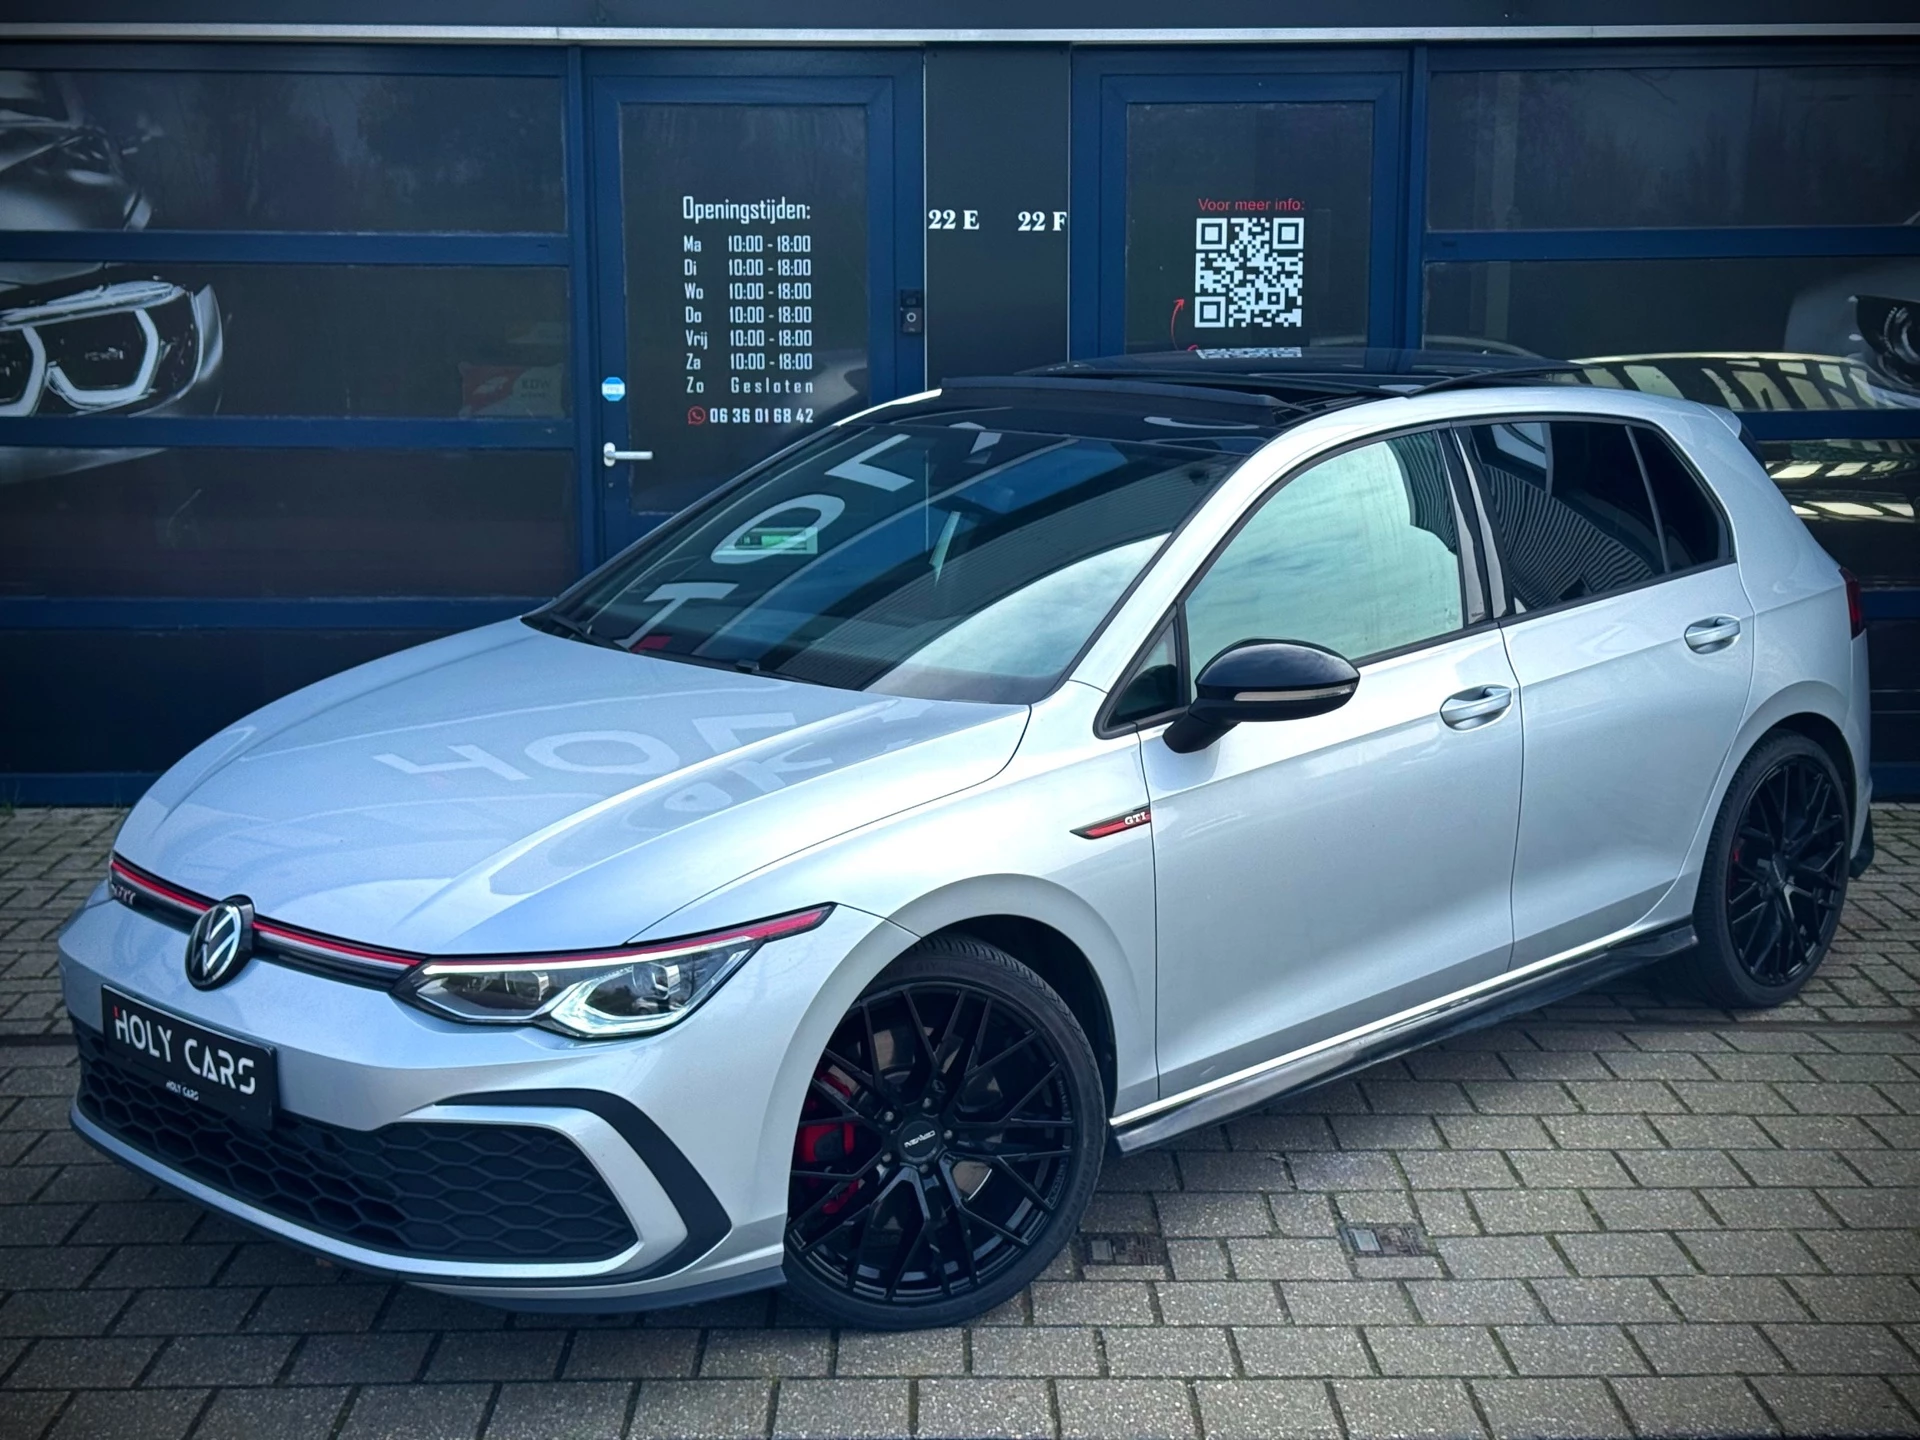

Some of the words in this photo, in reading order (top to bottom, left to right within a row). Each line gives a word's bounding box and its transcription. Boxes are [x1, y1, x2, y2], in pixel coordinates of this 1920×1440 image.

[682, 195, 811, 225] Openingstijden:
[1198, 198, 1231, 212] Voor
[1235, 200, 1271, 212] meer
[1274, 197, 1305, 212] info:
[928, 209, 957, 230] 22
[962, 209, 980, 230] E
[1017, 211, 1046, 232] 22
[1052, 211, 1067, 232] F
[683, 235, 702, 252] Ma
[728, 235, 763, 252] 10:00
[777, 235, 811, 252] 18:00
[684, 259, 697, 276] Di
[728, 259, 764, 276] 10:00
[777, 259, 811, 276] 18:00
[684, 282, 704, 299] Wo
[729, 282, 764, 299] 10:00
[777, 282, 812, 299] 18:00
[685, 306, 702, 323] Do
[729, 306, 765, 323] 10:00
[778, 306, 812, 323] 18:00
[685, 330, 708, 350] Vrij
[730, 330, 765, 347] 10:00
[778, 329, 813, 347] 18:00
[686, 353, 701, 370] Za
[730, 353, 765, 370] 10:00
[779, 353, 813, 370] 18:00
[686, 376, 704, 394] Zo
[730, 377, 814, 394] Gesloten
[709, 408, 728, 423] 06
[732, 408, 750, 423] 36
[754, 408, 769, 423] 01
[773, 408, 792, 423] 68
[795, 408, 814, 423] 42
[1124, 811, 1147, 825] GTI
[114, 1005, 172, 1063] HOLY
[183, 1038, 256, 1095] CARS
